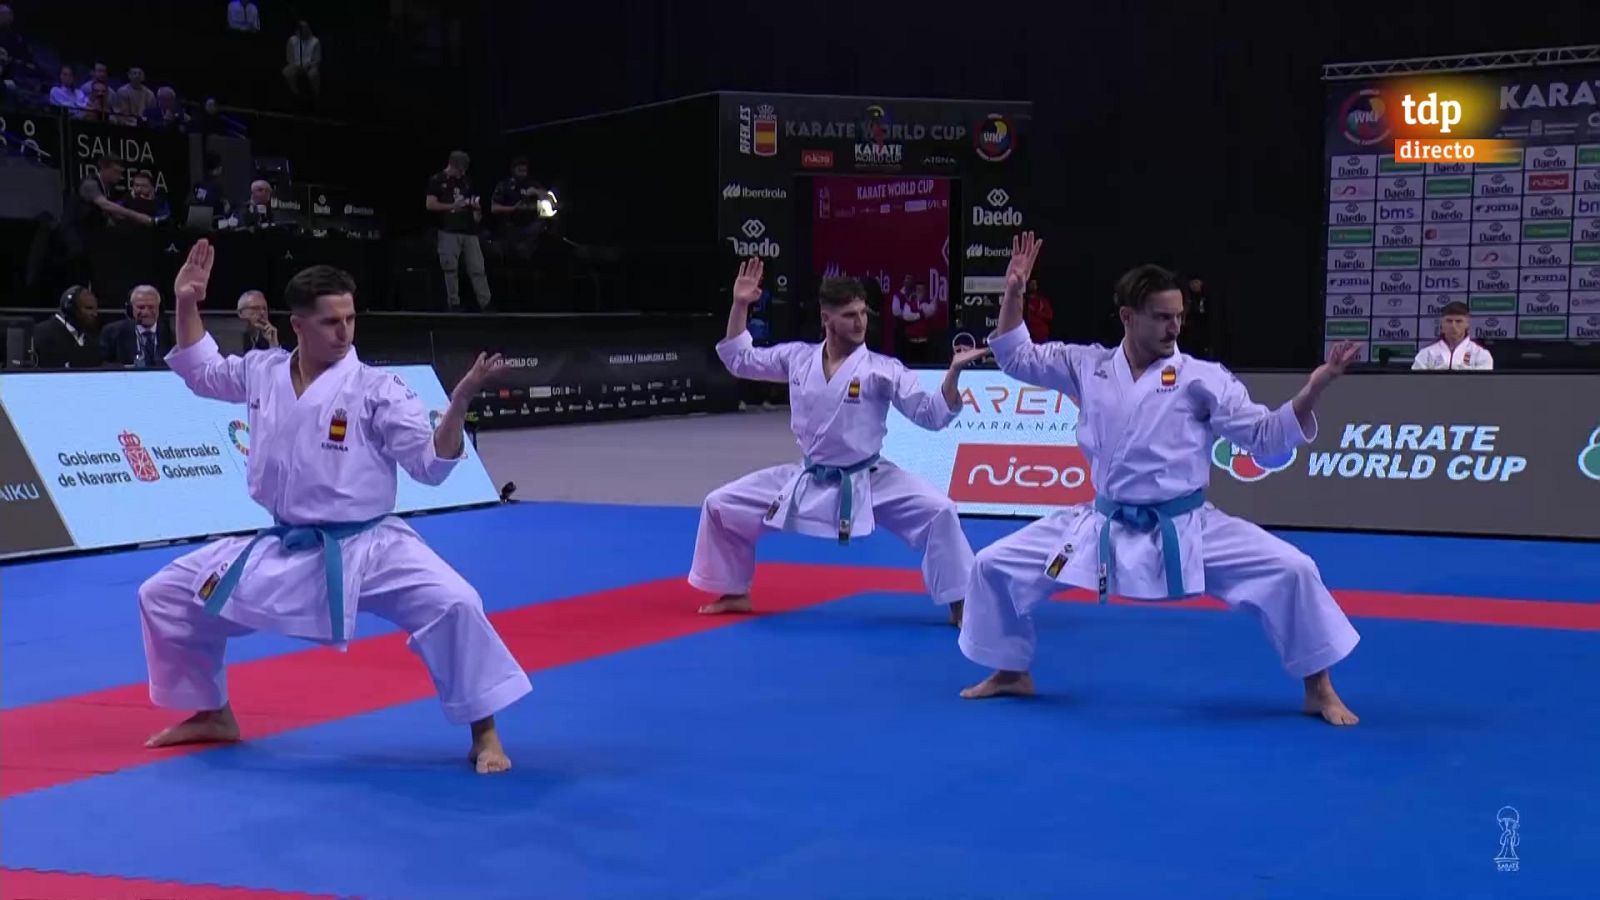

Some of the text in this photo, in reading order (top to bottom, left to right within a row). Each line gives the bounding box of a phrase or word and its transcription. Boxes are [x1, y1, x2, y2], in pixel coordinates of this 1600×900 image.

[1500, 81, 1600, 110] KARA
[785, 121, 856, 137] KARATE
[931, 125, 967, 141] CUP
[77, 133, 155, 165] SALIDA
[855, 144, 903, 155] KARATE
[1533, 157, 1567, 168] Daedo
[1338, 166, 1369, 176] Daedo
[742, 186, 787, 199] Iberdrola
[857, 180, 934, 200] KARATE WORLD CUP
[1384, 188, 1415, 199] Daedo
[1481, 184, 1514, 195] Daedo
[972, 207, 1022, 225] Daedo
[1380, 205, 1414, 220] bms
[1431, 210, 1464, 221] Daedo
[1530, 206, 1564, 217] Daedo
[1336, 213, 1367, 223] Daedo
[1382, 234, 1413, 245] Daedo
[1480, 232, 1511, 242] Daedo
[1334, 259, 1364, 269] Daedo
[1429, 258, 1461, 267] Daedo
[1529, 255, 1562, 265] Daedo
[1380, 282, 1411, 292] Daedo
[1425, 275, 1460, 288] bms
[1477, 280, 1509, 290] Daedo
[1333, 305, 1363, 316] Daedo
[1526, 303, 1559, 313] Daedo
[1379, 328, 1410, 338] Daedo
[1475, 327, 1507, 337] Daedo
[954, 420, 1024, 431] AVARRA
[1340, 424, 1500, 451] KARATE
[152, 444, 220, 460] Nafarroako
[58, 450, 121, 467] Gobierno
[162, 464, 223, 479] Gobernua
[1308, 452, 1528, 482] WORLD CUP
[58, 470, 132, 488] de Navarra
